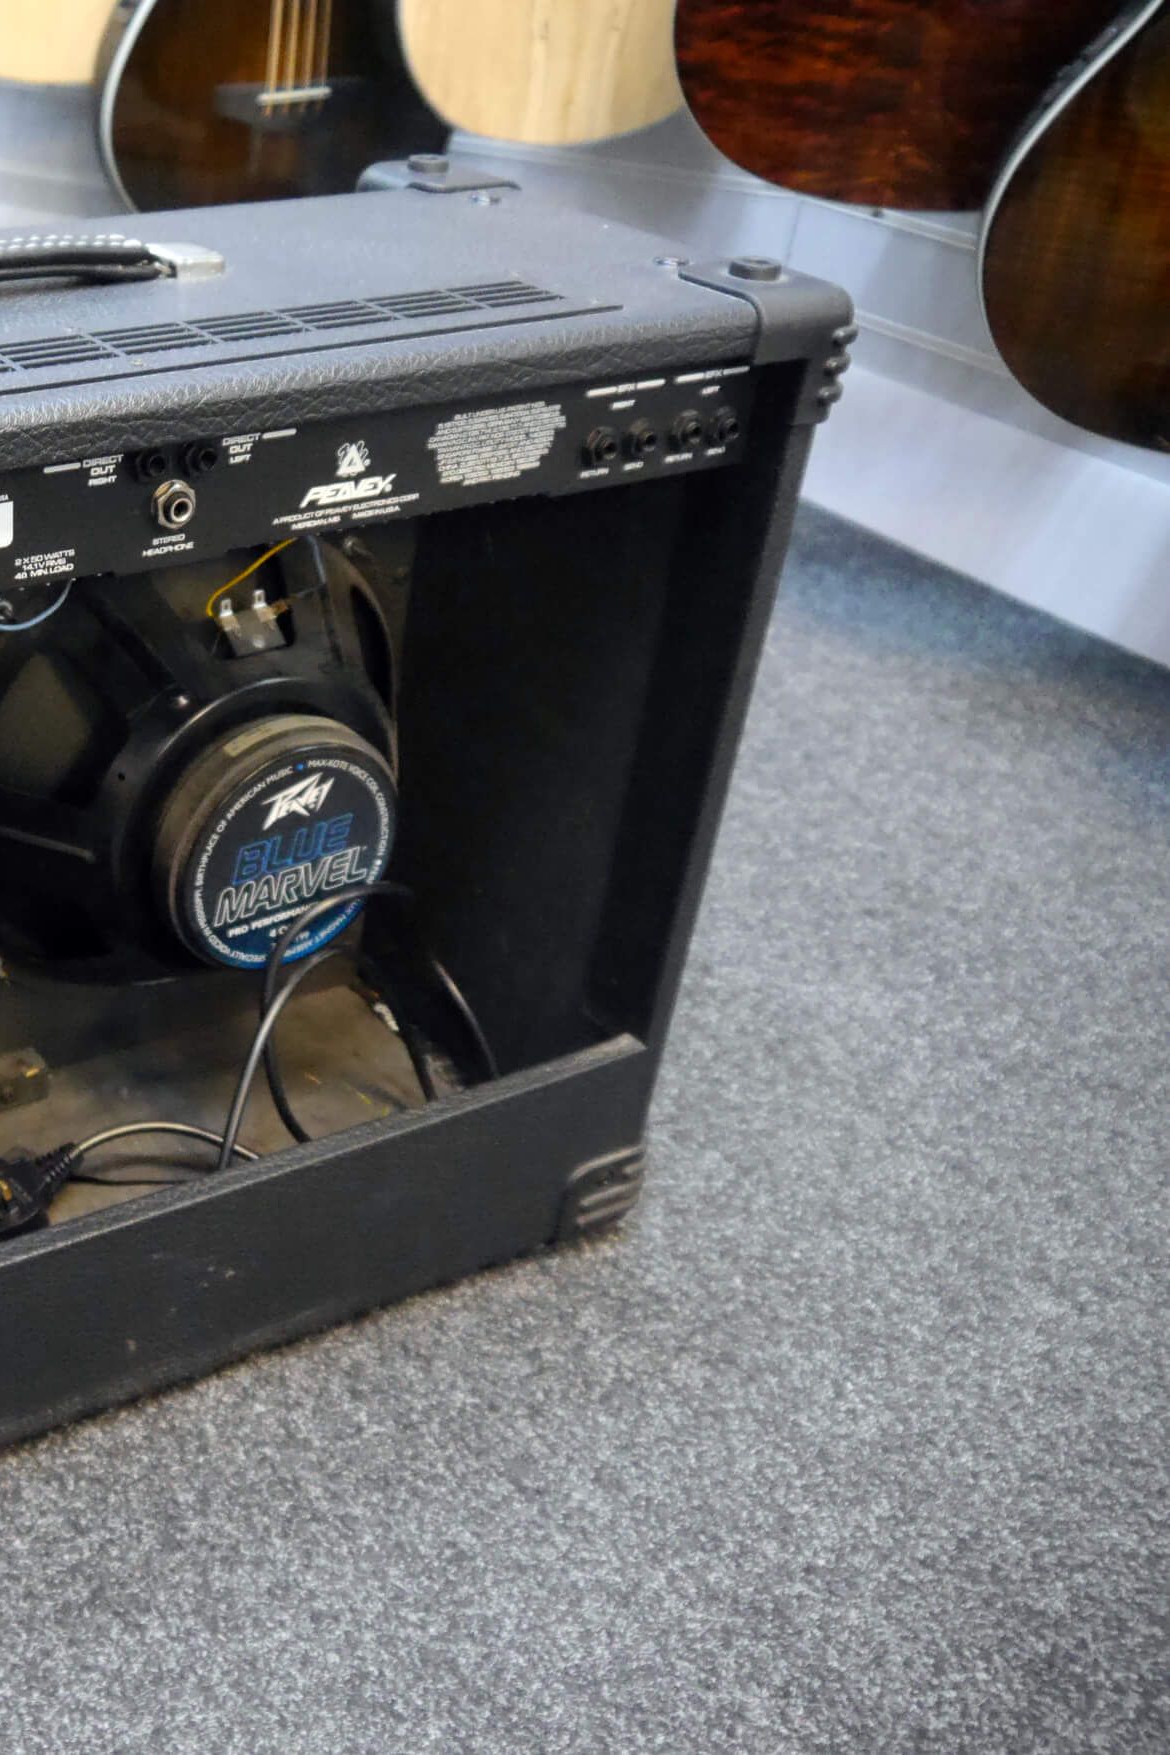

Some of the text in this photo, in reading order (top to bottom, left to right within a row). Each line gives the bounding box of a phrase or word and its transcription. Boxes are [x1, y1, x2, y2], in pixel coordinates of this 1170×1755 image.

[222, 432, 261, 446] DIRECT
[228, 443, 253, 455] OUT
[82, 454, 124, 468] DIRECT
[228, 453, 252, 465] LEFT
[90, 464, 116, 477] OUT
[87, 475, 118, 487] RIGHT
[299, 473, 397, 509] PEAVEY
[152, 533, 186, 546] STEREO
[43, 548, 75, 561] WATTS
[142, 541, 194, 557] HEADPHONE
[49, 563, 75, 574] LOAD
[265, 766, 294, 783] MUSIC
[226, 782, 266, 820] AMERICAN
[262, 772, 335, 831] PEAVEY
[216, 819, 228, 833] OF
[232, 812, 354, 886] BLUE
[195, 832, 221, 887] BIRTHPLACE
[213, 846, 367, 928] MARVEL
[227, 925, 249, 938] PRO
[209, 934, 231, 954] VOICED
